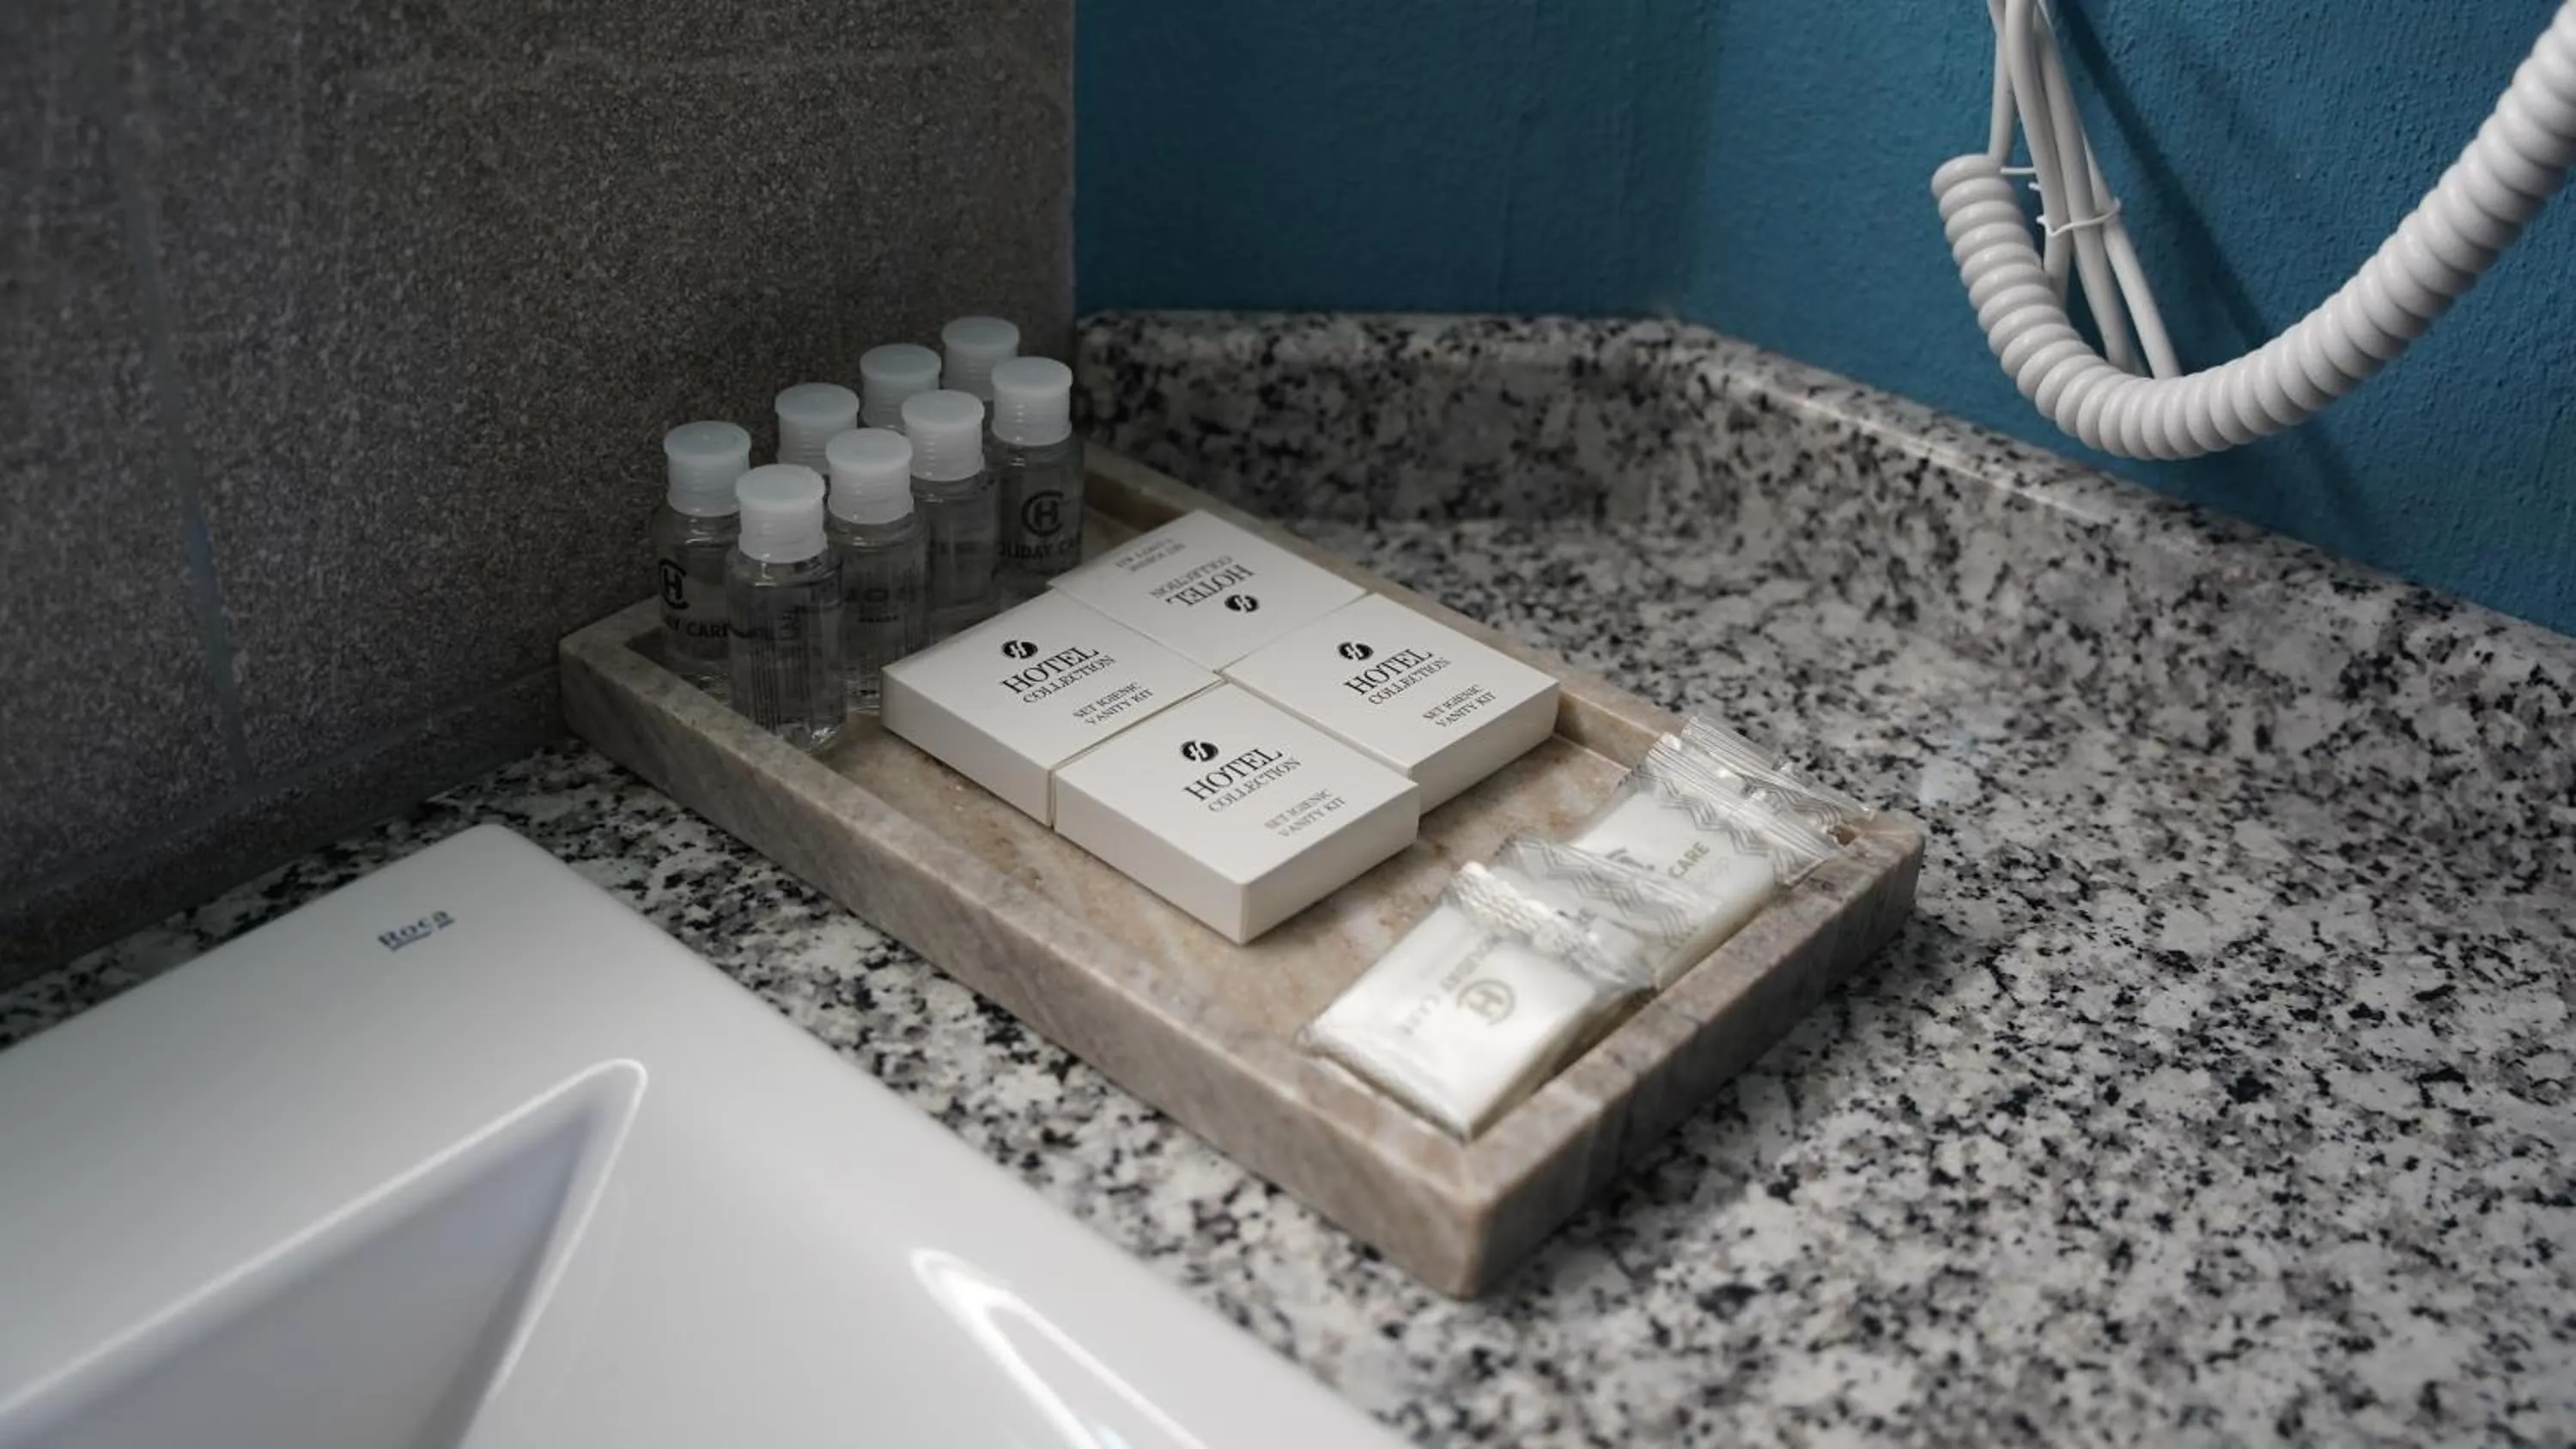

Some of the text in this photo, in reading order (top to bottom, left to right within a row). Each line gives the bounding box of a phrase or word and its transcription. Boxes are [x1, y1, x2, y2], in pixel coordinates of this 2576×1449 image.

[1165, 564, 1255, 606] HOTEL
[1002, 646, 1099, 694] HOTEL
[1023, 655, 1115, 703] COLLECTION
[1344, 648, 1433, 695] HOTEL
[1368, 657, 1451, 705] COLLECTION
[1475, 691, 1497, 706] KIT
[1182, 748, 1284, 802] HOTEL
[1207, 756, 1302, 812] COLLECTION
[1323, 796, 1346, 812] KIT
[1668, 840, 1710, 879] CARE
[378, 910, 452, 950] Roca
